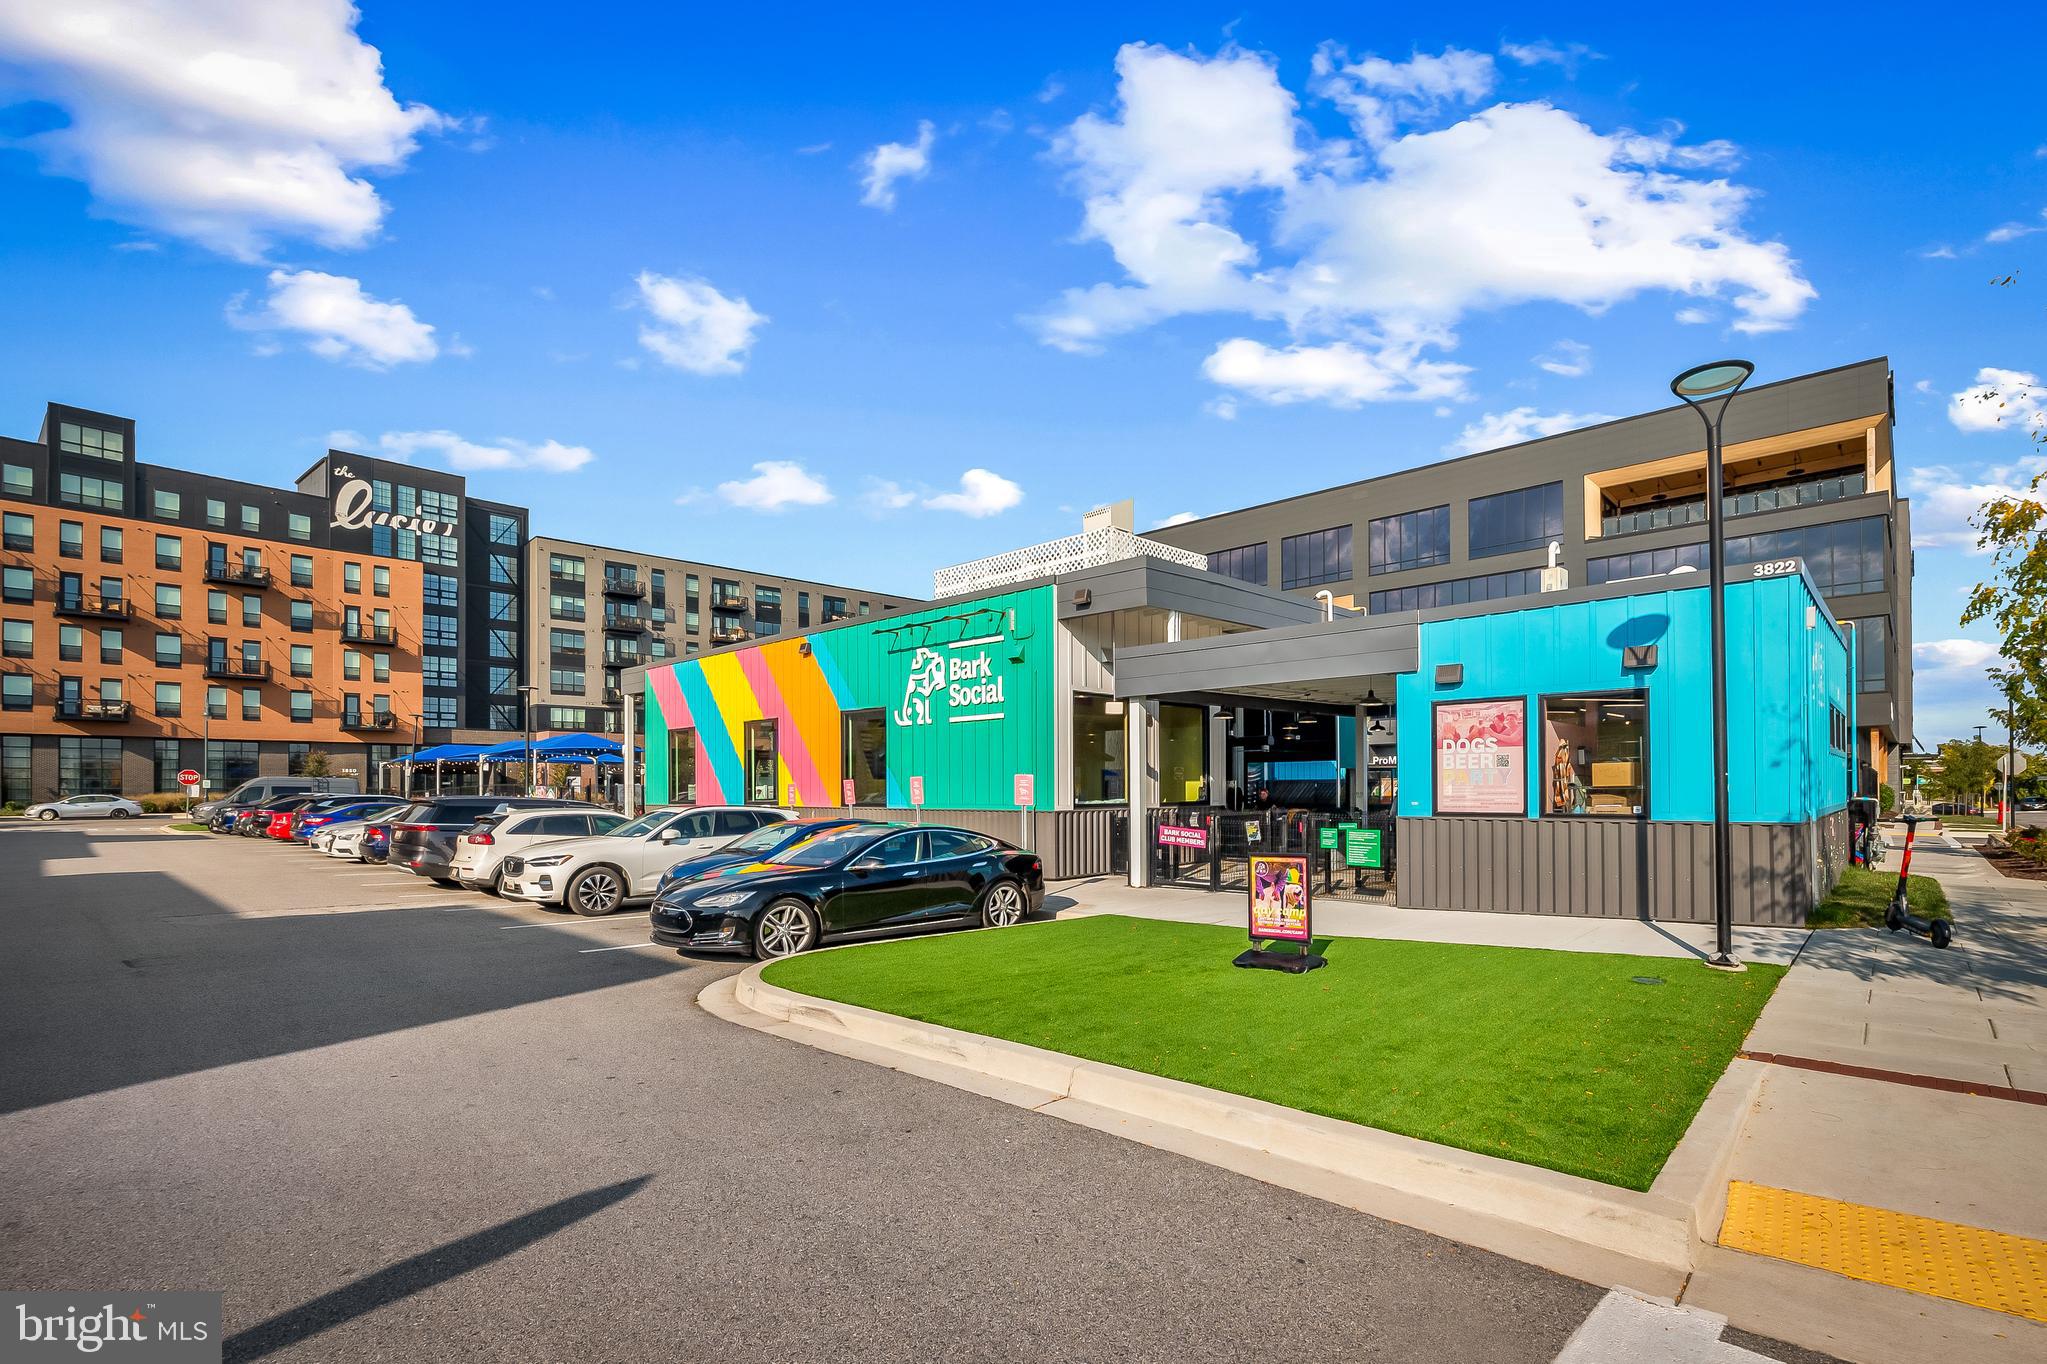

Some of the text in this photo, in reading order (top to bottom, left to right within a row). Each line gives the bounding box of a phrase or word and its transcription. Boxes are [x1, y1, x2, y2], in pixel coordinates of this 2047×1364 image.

[1753, 560, 1796, 577] 3822
[949, 651, 992, 681] Bark
[949, 676, 1004, 707] Social
[1442, 738, 1498, 753] DOGS
[1372, 756, 1397, 765] ProM
[1442, 753, 1494, 769] BEER
[1442, 769, 1511, 785] PARTY
[1176, 836, 1206, 846] MEMBERS
[1181, 830, 1202, 838] SOCIAL
